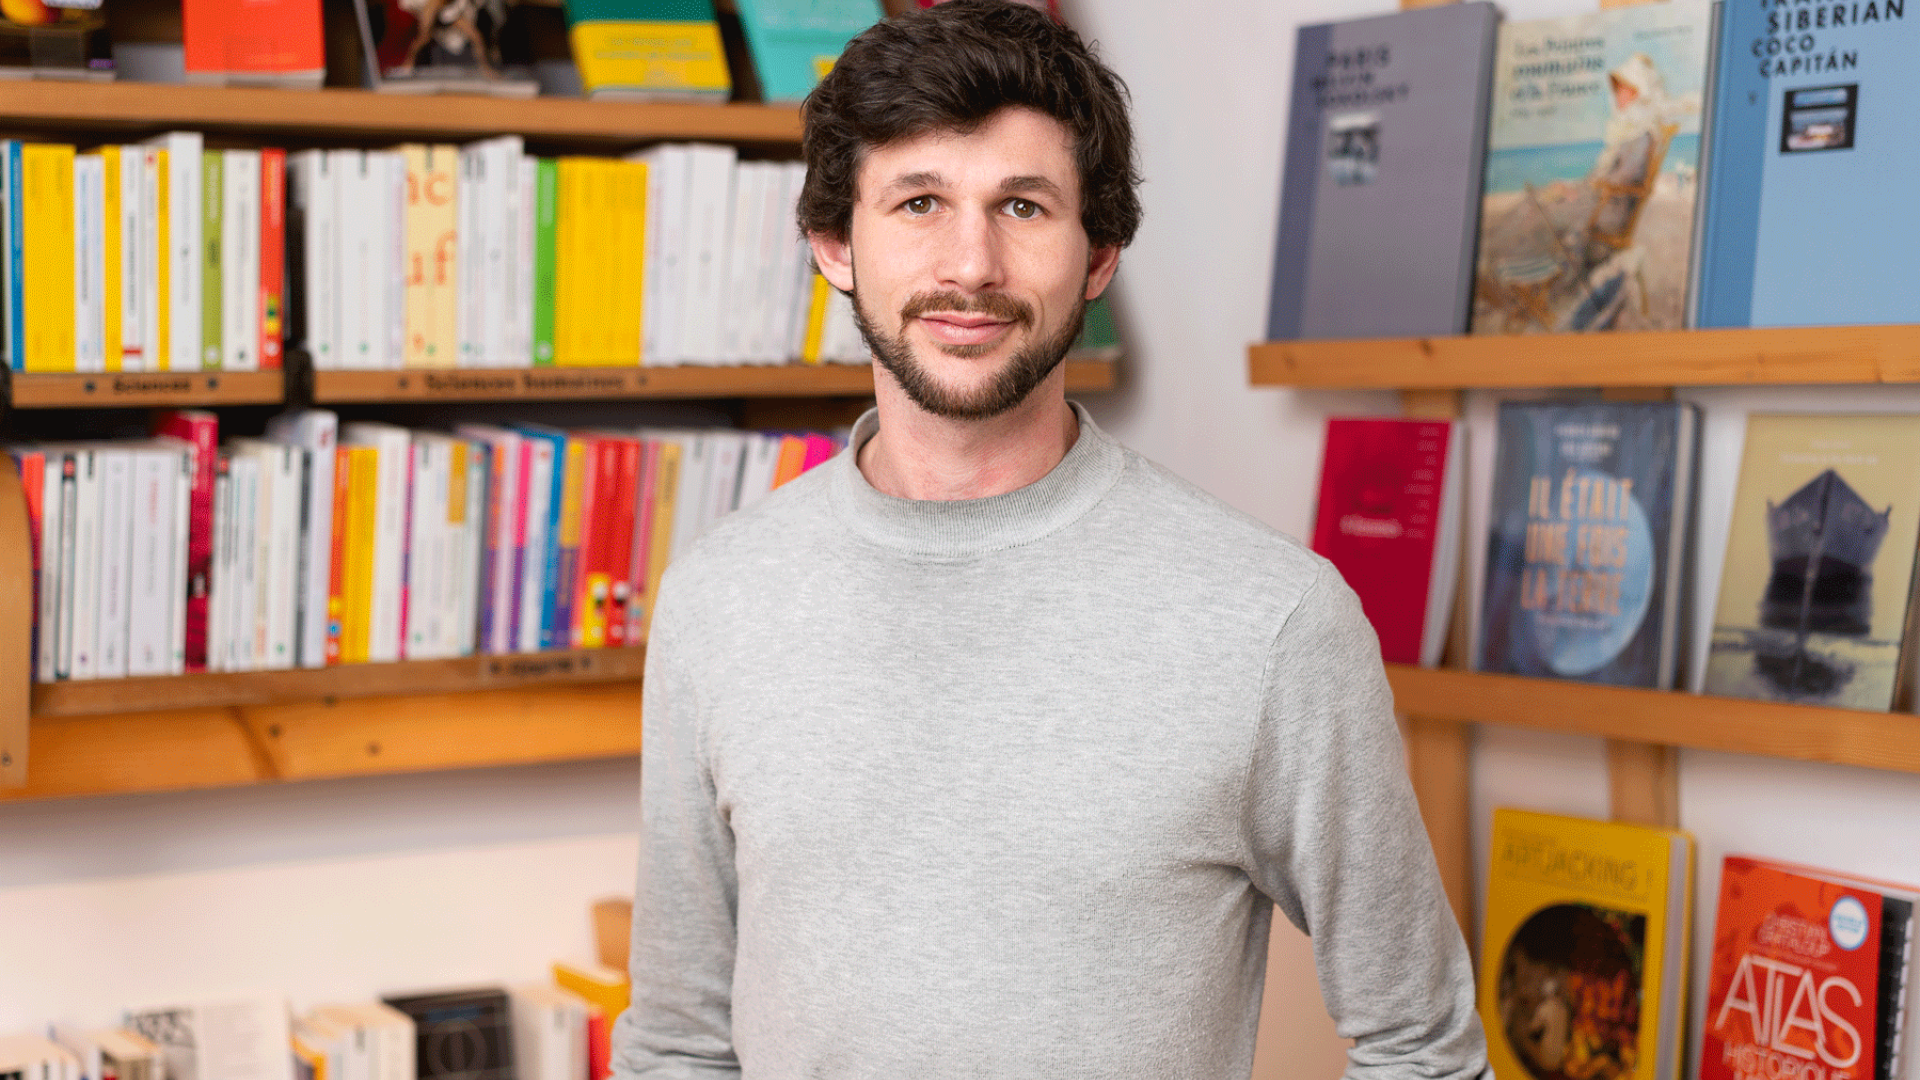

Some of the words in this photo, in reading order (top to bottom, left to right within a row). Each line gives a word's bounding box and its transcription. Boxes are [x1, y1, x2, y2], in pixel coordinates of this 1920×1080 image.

[1767, 0, 1904, 35] SIBERIAN
[1751, 33, 1815, 58] COCO
[1758, 47, 1858, 79] CAPITÁN
[1713, 952, 1863, 1069] ATLAS
